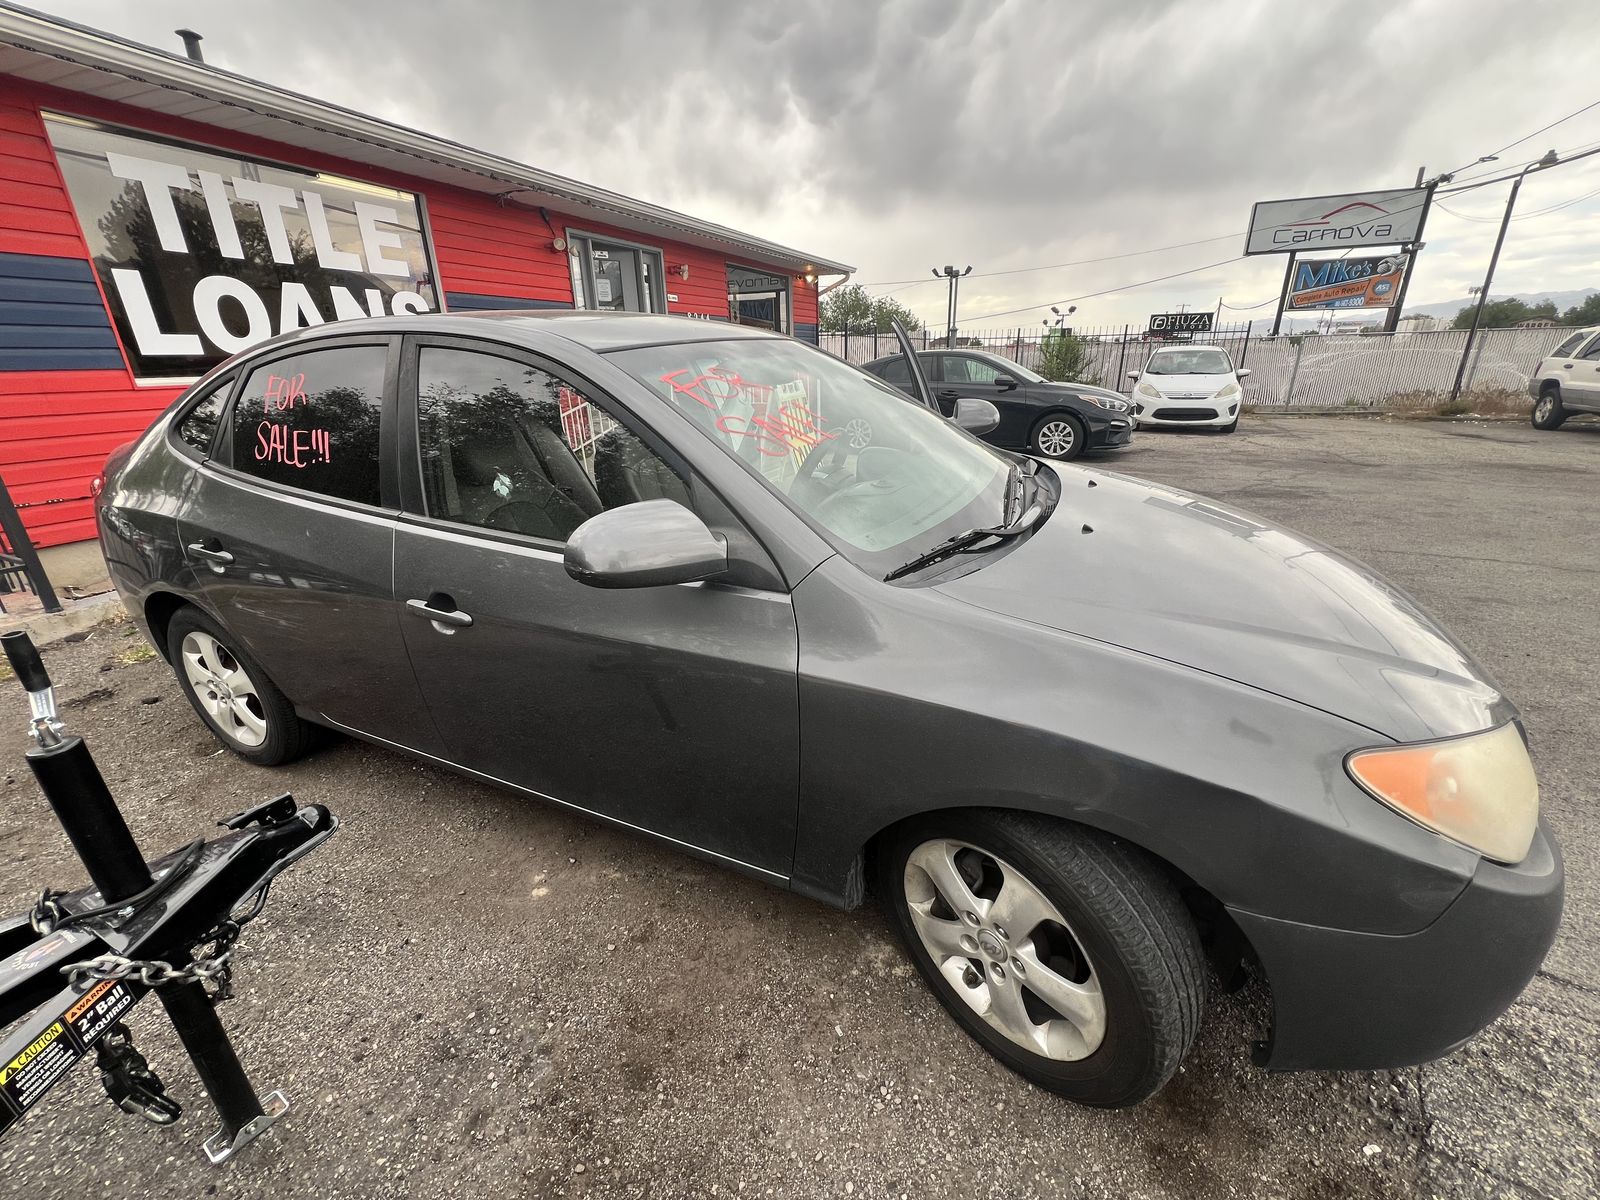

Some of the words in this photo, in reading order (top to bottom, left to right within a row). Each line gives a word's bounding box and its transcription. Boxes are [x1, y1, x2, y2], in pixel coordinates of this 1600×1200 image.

[106, 152, 410, 278] TITLE
[1273, 224, 1392, 244] Carnova
[1295, 259, 1373, 292] Mike's
[1296, 292, 1322, 305] Complete
[1323, 289, 1341, 299] Auto
[1341, 284, 1367, 295] Repair
[1168, 315, 1210, 325] FIUZA
[264, 373, 307, 413] FOR
[255, 421, 330, 468] SALE!!!
[76, 979, 112, 1012] WARNIN
[95, 984, 124, 1015] Ball
[83, 996, 131, 1043] REQUIRED
[17, 1026, 60, 1065] CAUTION
[15, 1071, 26, 1080] DO
[25, 1060, 37, 1072] NOT
